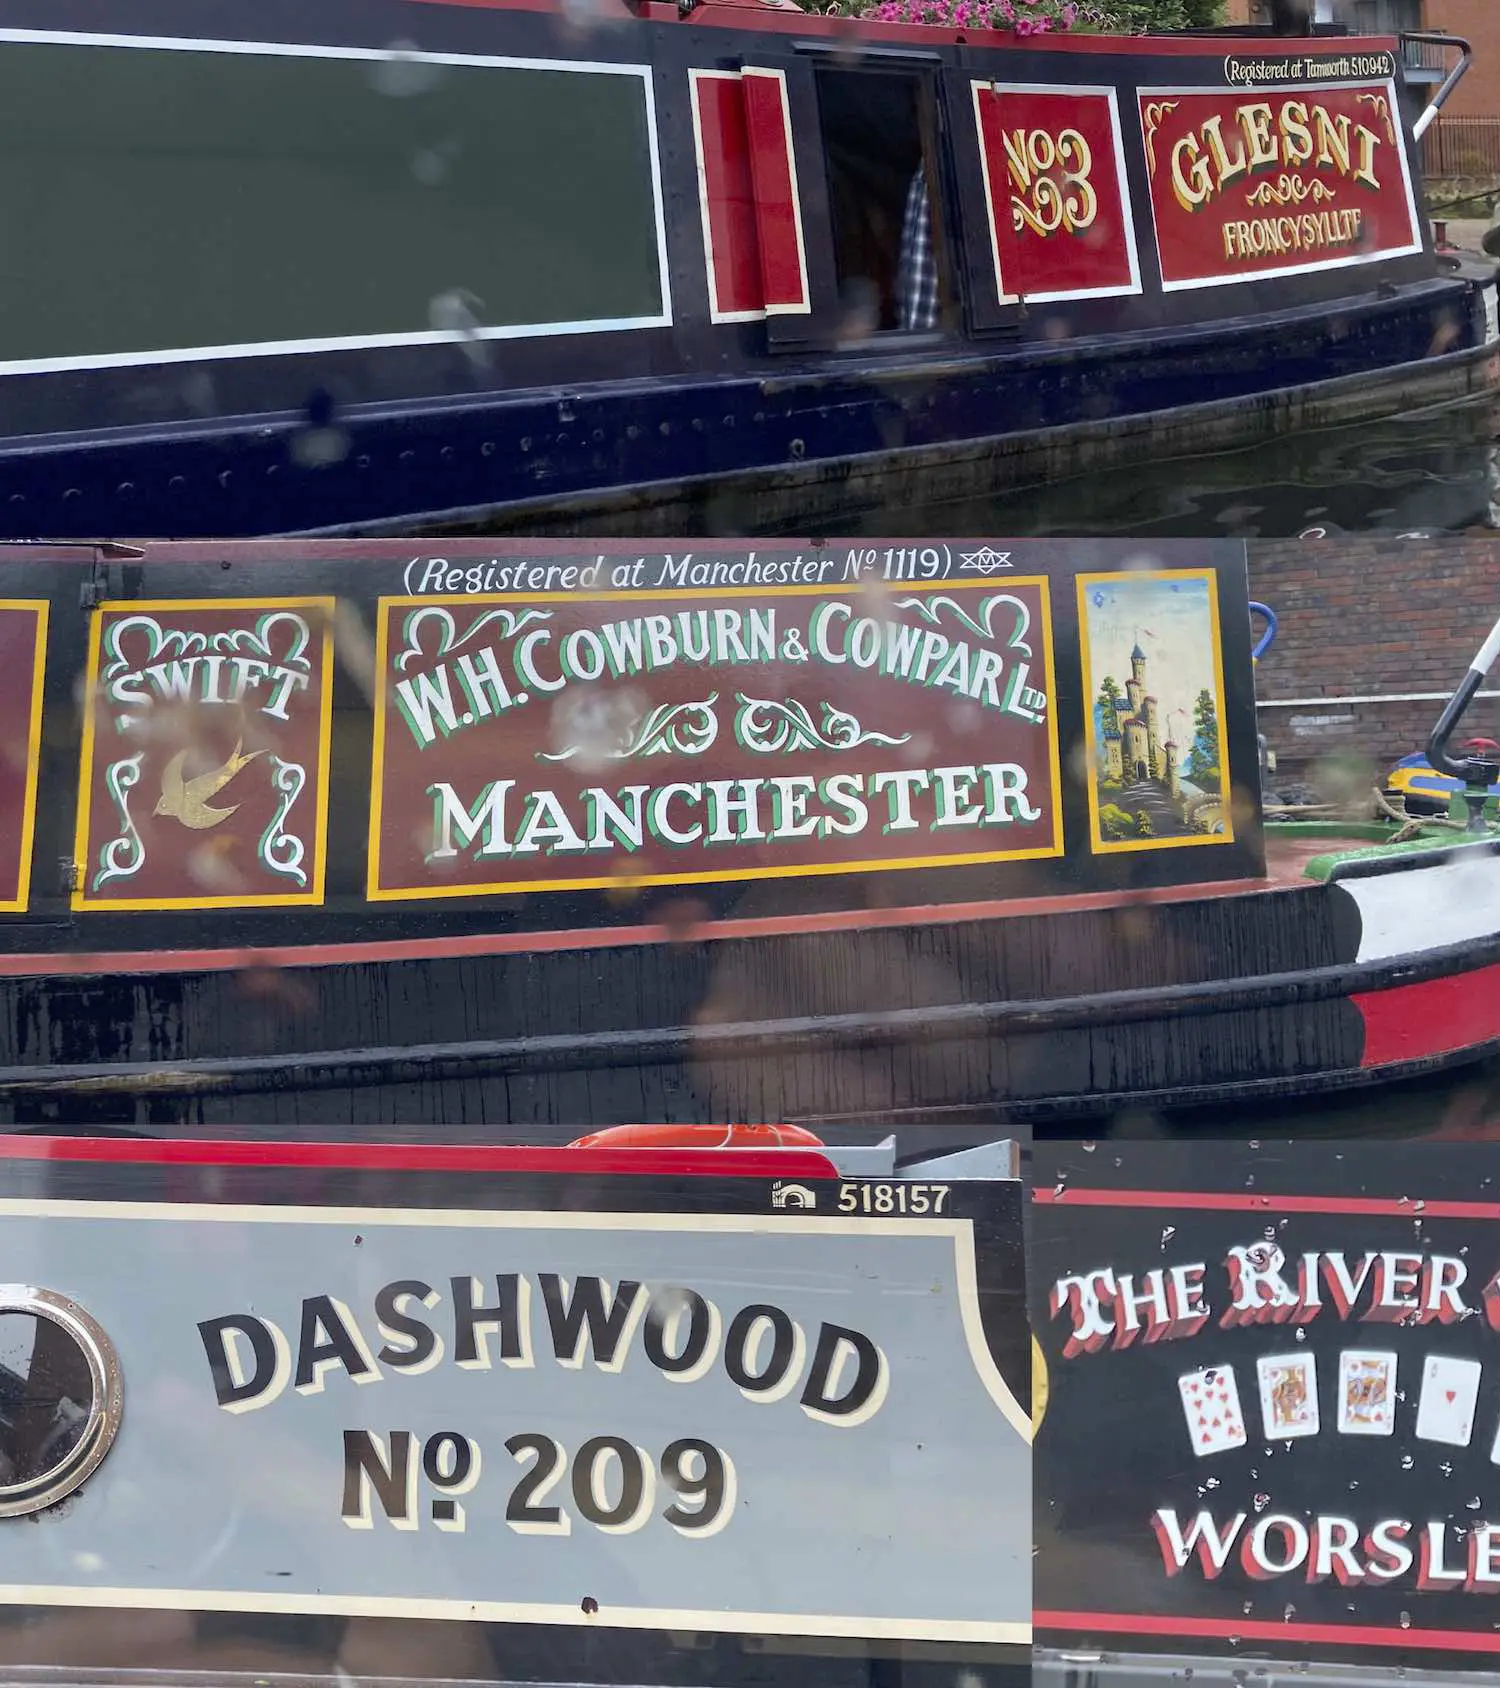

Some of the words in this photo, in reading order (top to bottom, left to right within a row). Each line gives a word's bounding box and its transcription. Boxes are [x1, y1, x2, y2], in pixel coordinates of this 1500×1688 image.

[1224, 55, 1288, 87] (Registered
[1290, 60, 1302, 79] at
[1304, 58, 1349, 78] Tamworth
[1351, 50, 1396, 80] 510942)
[1172, 101, 1381, 208] GLESNI
[404, 555, 604, 596] (Registered
[611, 558, 636, 588] at
[653, 552, 834, 588] Manchester
[883, 544, 952, 580] 1119)
[110, 654, 310, 731] SWIFT
[518, 608, 776, 692] COWBURN
[782, 627, 808, 662] &
[815, 600, 1004, 707] COWPAR
[434, 762, 1041, 860] MANCHESTER
[838, 1183, 949, 1213] 518157
[196, 1273, 890, 1414] DASHWOOD
[1055, 1263, 1210, 1348] THE
[1226, 1241, 1472, 1316] RIVER
[505, 1433, 737, 1537] 209
